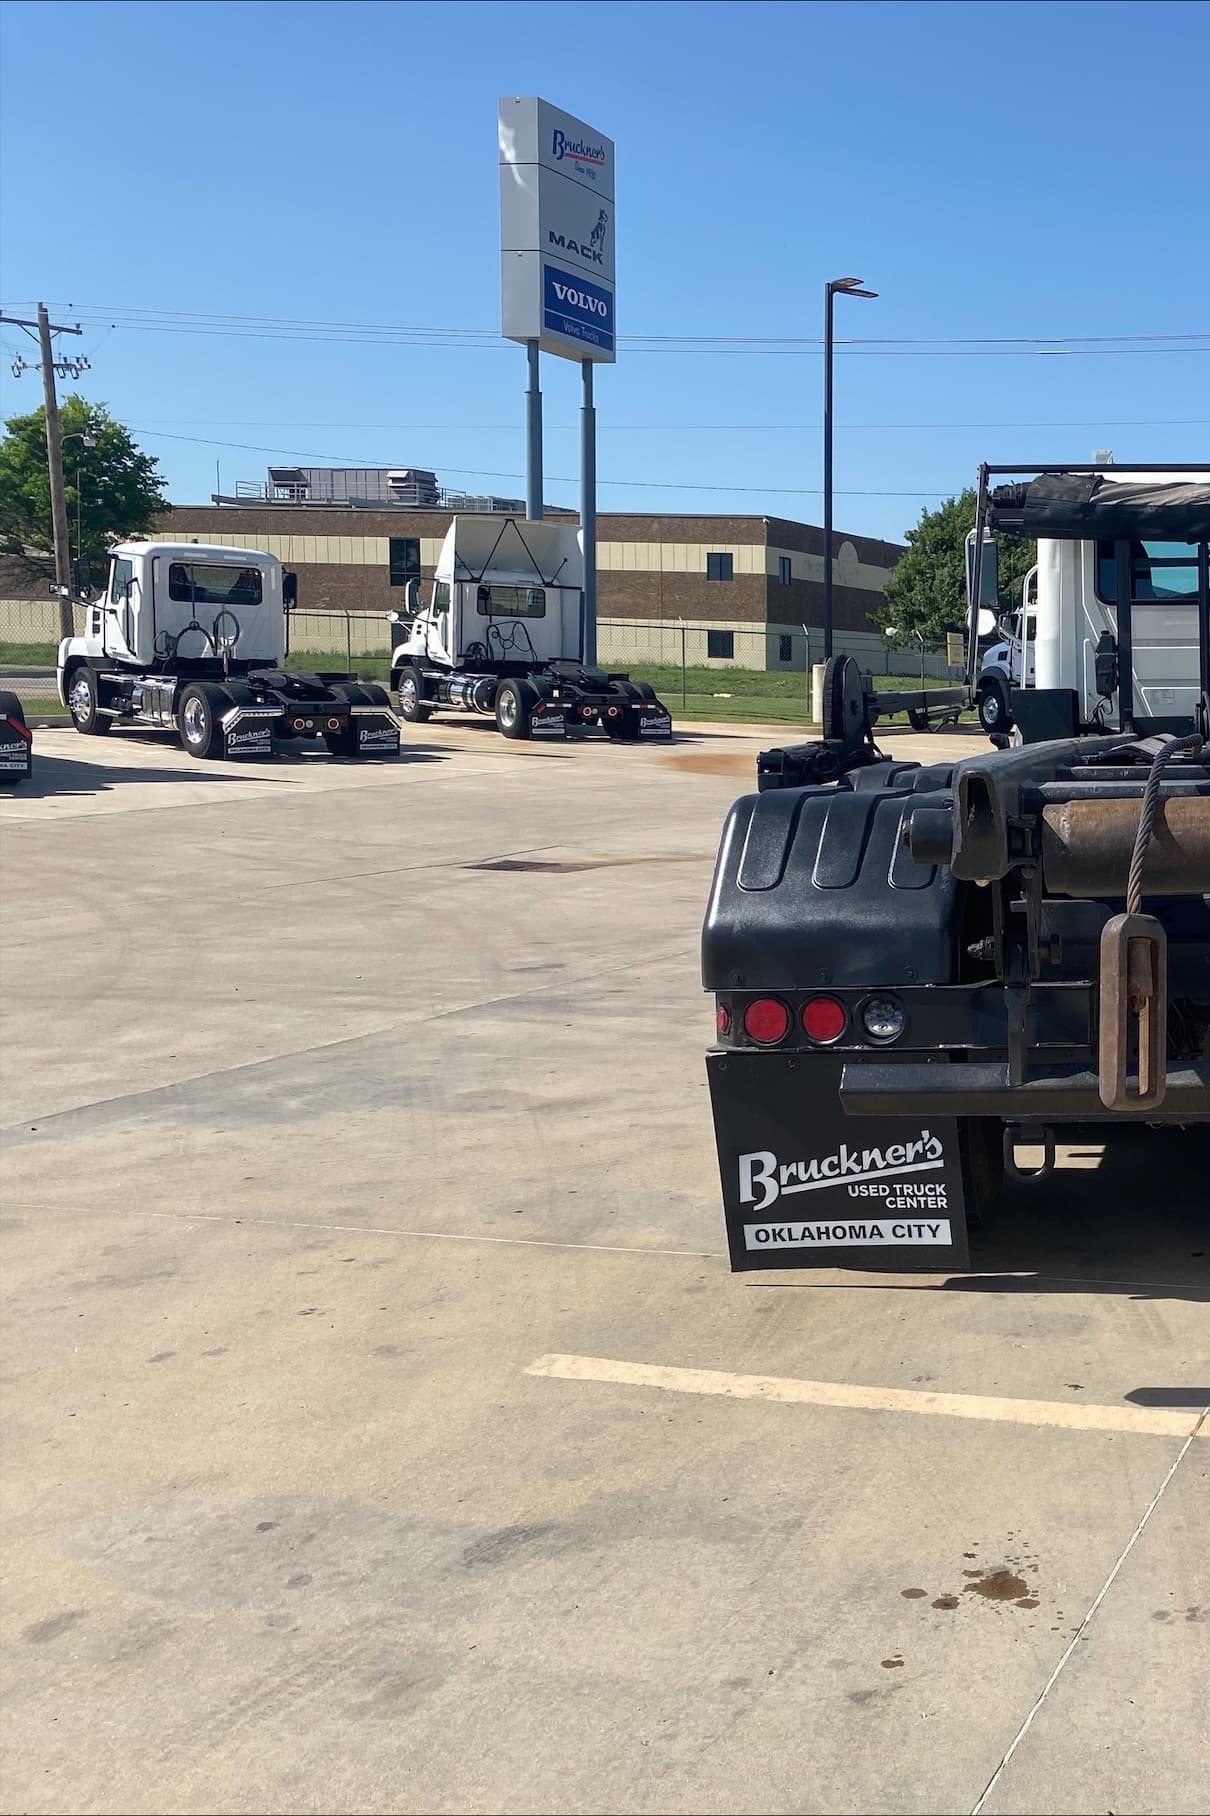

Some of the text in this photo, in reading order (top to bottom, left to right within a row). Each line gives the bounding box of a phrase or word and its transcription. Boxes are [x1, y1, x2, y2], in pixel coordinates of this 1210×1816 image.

[552, 128, 605, 160] Bruckner's
[549, 230, 604, 265] MACK
[552, 281, 608, 317] VOLVO
[738, 1129, 943, 1212] Bruckner's
[848, 1183, 947, 1197] USED TRUCK
[885, 1196, 948, 1209] CENTER
[755, 1223, 941, 1243] OKLAHOMA CITY
